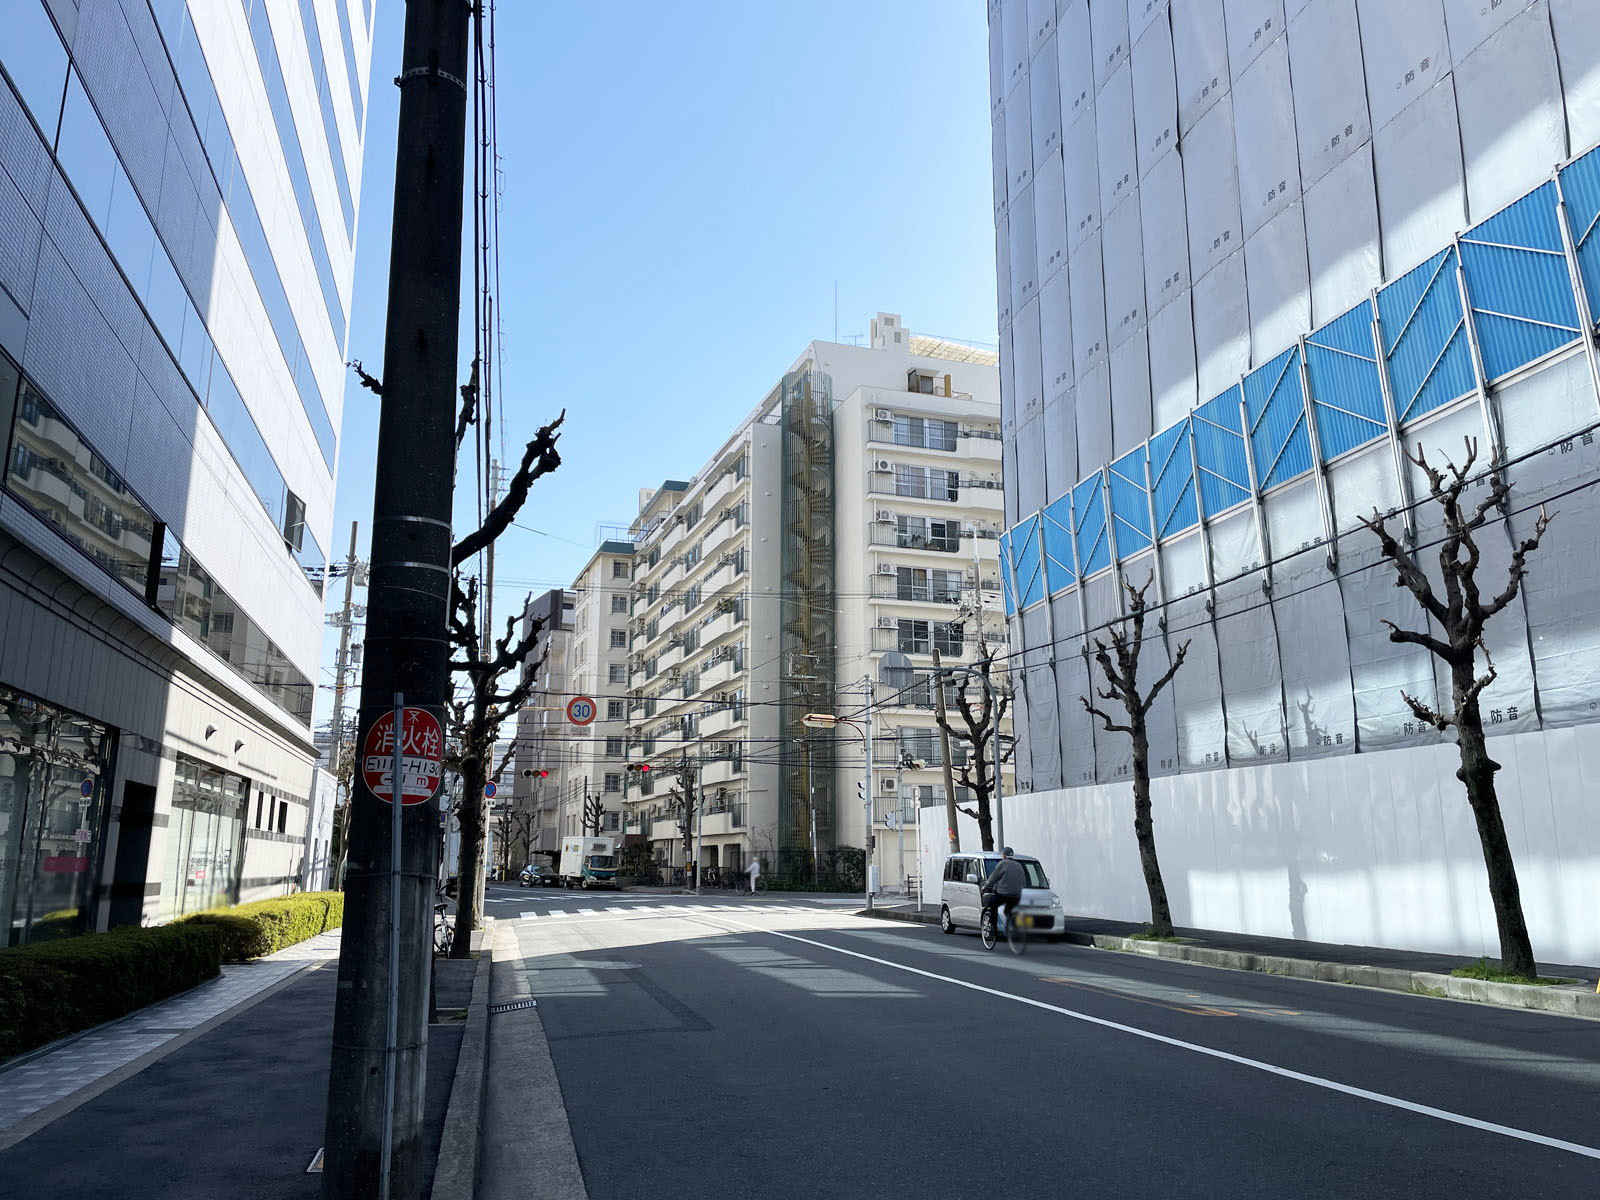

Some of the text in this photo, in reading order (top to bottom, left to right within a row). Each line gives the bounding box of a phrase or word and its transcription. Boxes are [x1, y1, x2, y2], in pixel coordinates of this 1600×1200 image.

[1405, 57, 1431, 86] 防音
[1331, 124, 1353, 149] 防音
[1268, 180, 1286, 202] 防音
[1213, 230, 1230, 249] 防音
[573, 704, 590, 718] 30
[1490, 705, 1519, 724] 防音
[1403, 721, 1426, 736] 防音
[375, 721, 440, 757] 消火栓
[1323, 733, 1344, 747] 防音
[416, 777, 427, 786] m
